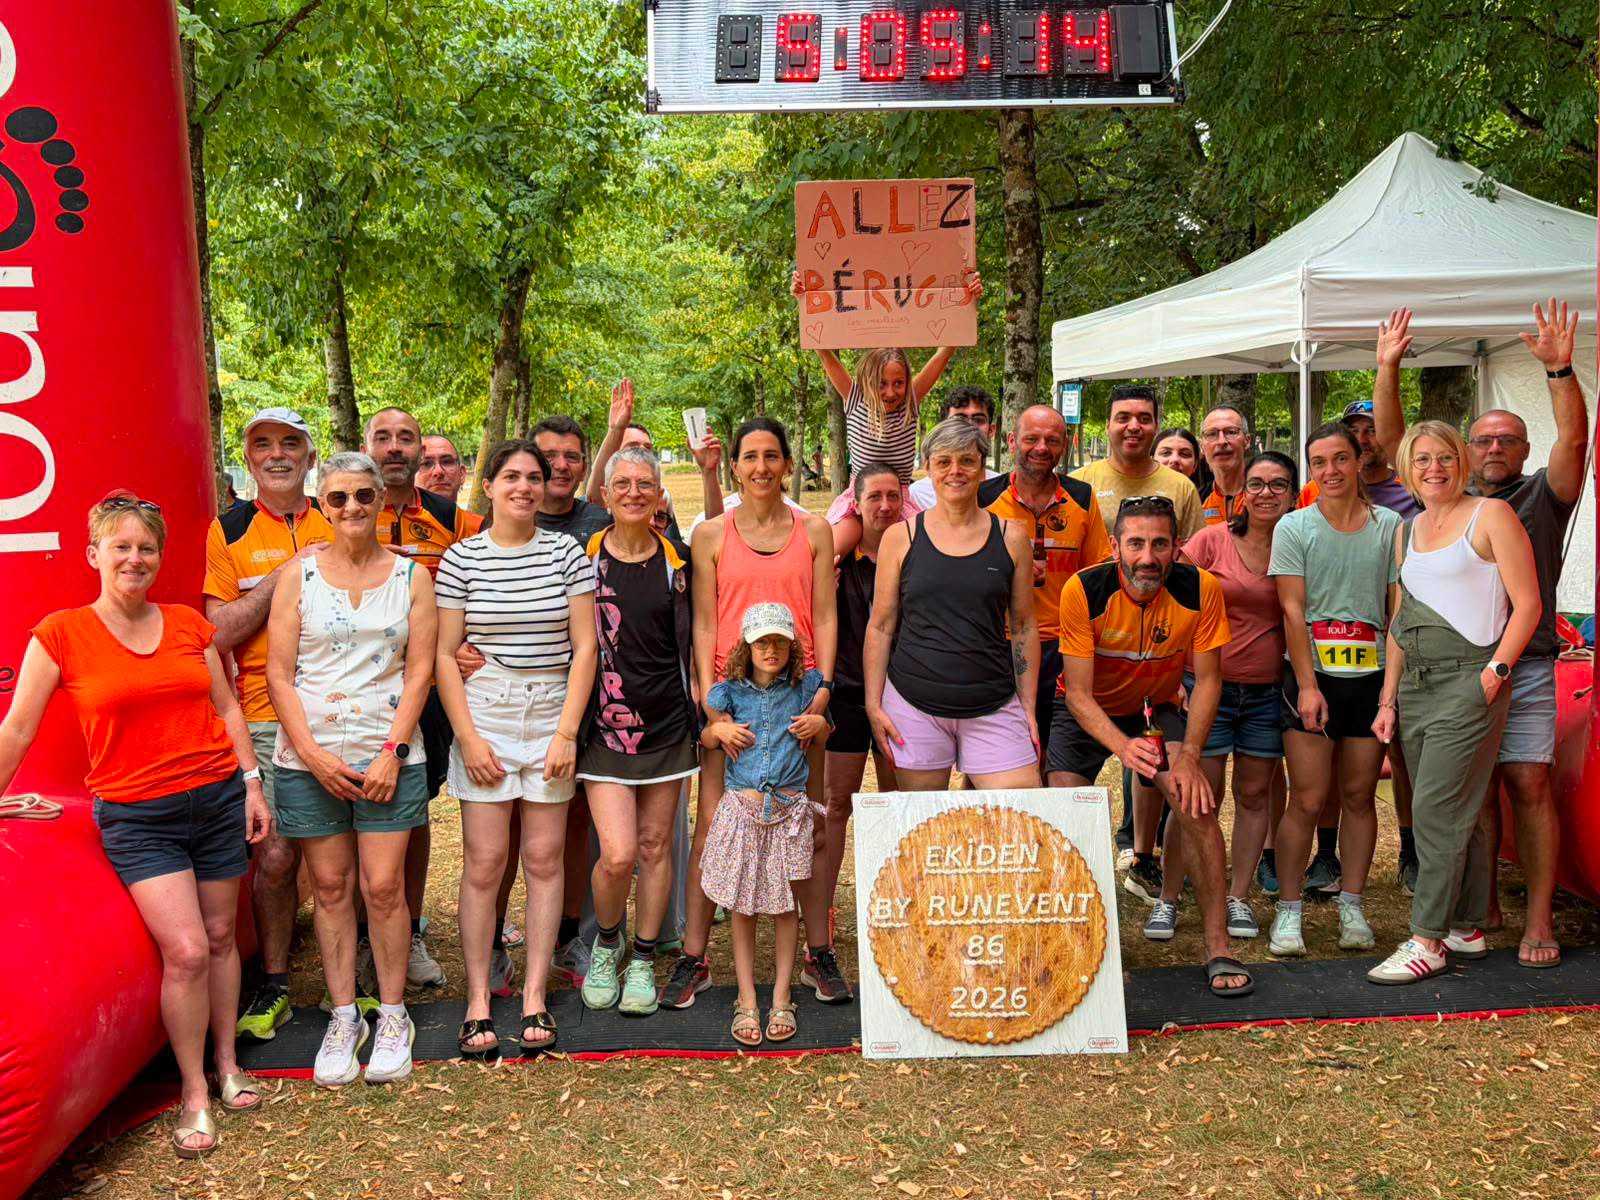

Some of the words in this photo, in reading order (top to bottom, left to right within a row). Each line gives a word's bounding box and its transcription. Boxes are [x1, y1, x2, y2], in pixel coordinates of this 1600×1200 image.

[807, 184, 974, 239] ALLEZ
[803, 257, 977, 314] BÉRUGES
[1325, 647, 1367, 665] 11F
[874, 897, 913, 920] BY
[927, 893, 1095, 918] RUNEVENT
[967, 934, 1004, 958] 86
[950, 986, 1028, 1009] 2026
